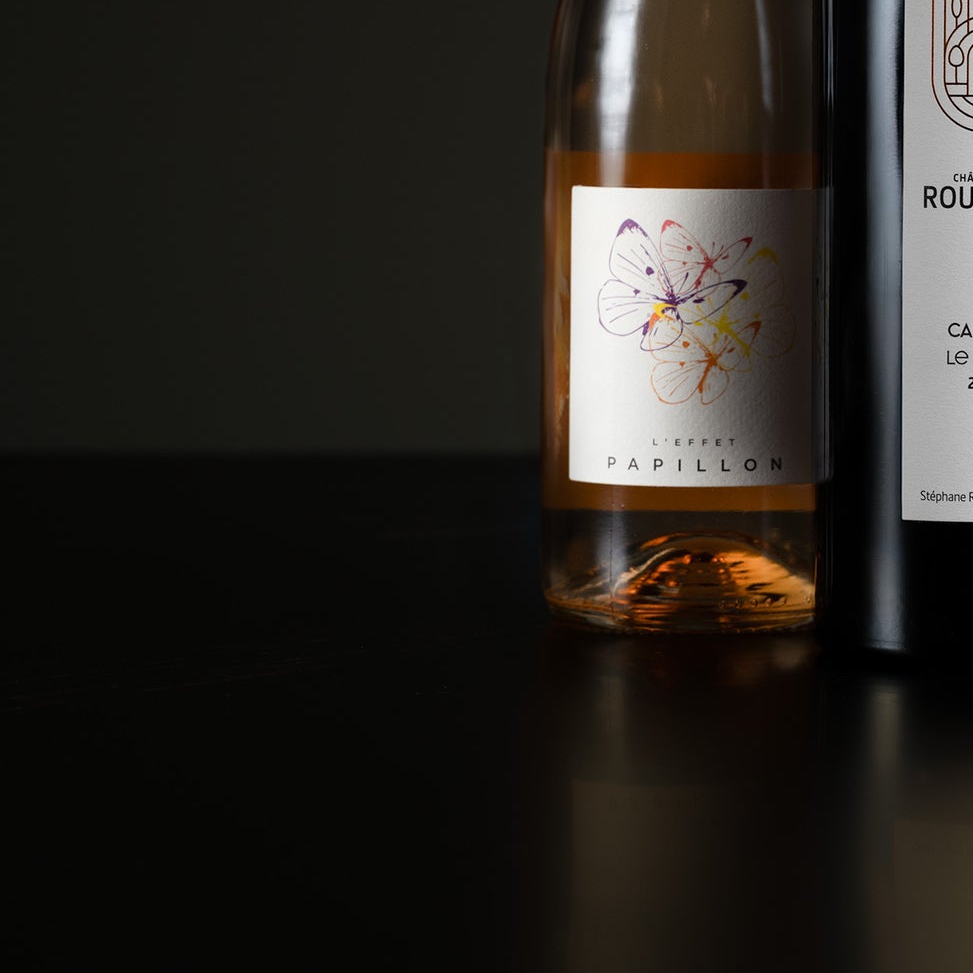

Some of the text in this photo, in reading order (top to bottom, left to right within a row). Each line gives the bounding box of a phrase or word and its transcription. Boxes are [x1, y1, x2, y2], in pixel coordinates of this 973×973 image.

[653, 438, 736, 447] L'EFFET
[607, 456, 782, 472] PAPILLON
[920, 490, 967, 504] Stéphane
